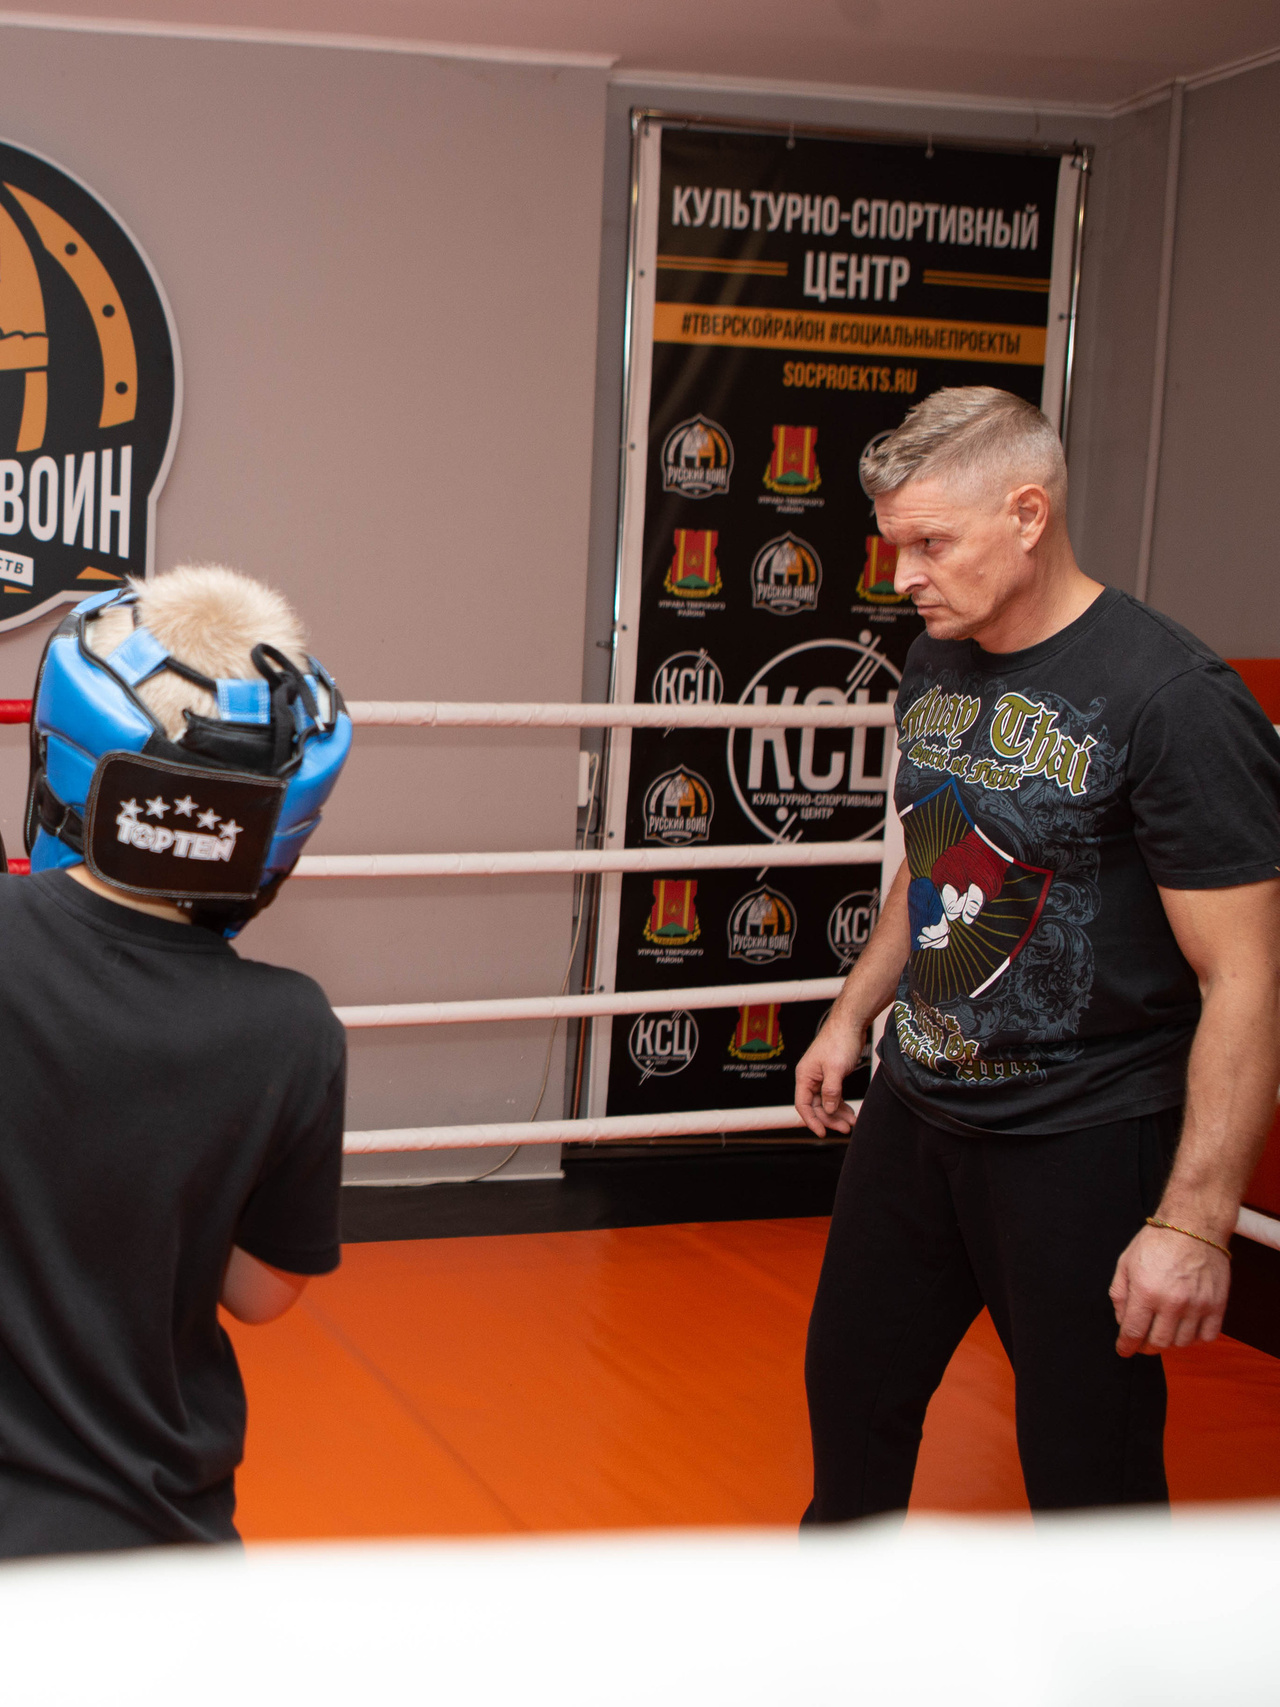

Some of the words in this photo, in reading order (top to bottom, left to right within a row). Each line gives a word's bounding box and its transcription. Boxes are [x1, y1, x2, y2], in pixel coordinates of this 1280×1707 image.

[671, 186, 1040, 251] КУЛЬТУРНО-СПОРТИВНЫЙ
[803, 250, 911, 302] ЦЕНТР
[681, 311, 825, 342] #ТВЕРСКОЙРАЙОН
[828, 319, 1020, 356] #СОЦИАЛЬНЫЕПРОЕКТЫ
[782, 361, 918, 394] SOCPROEKTS.RU
[990, 692, 1098, 796] Thai
[965, 758, 1021, 790] Fight
[752, 792, 883, 807] КУЛЬТУРНО-СПОРТИВНЫЙ
[800, 807, 834, 820] ЦЕНТР
[649, 815, 684, 833] РУССКИЙ
[685, 815, 707, 834] ВОИН
[733, 934, 767, 950] РУССКИЙ
[636, 1019, 691, 1060] КСЦ
